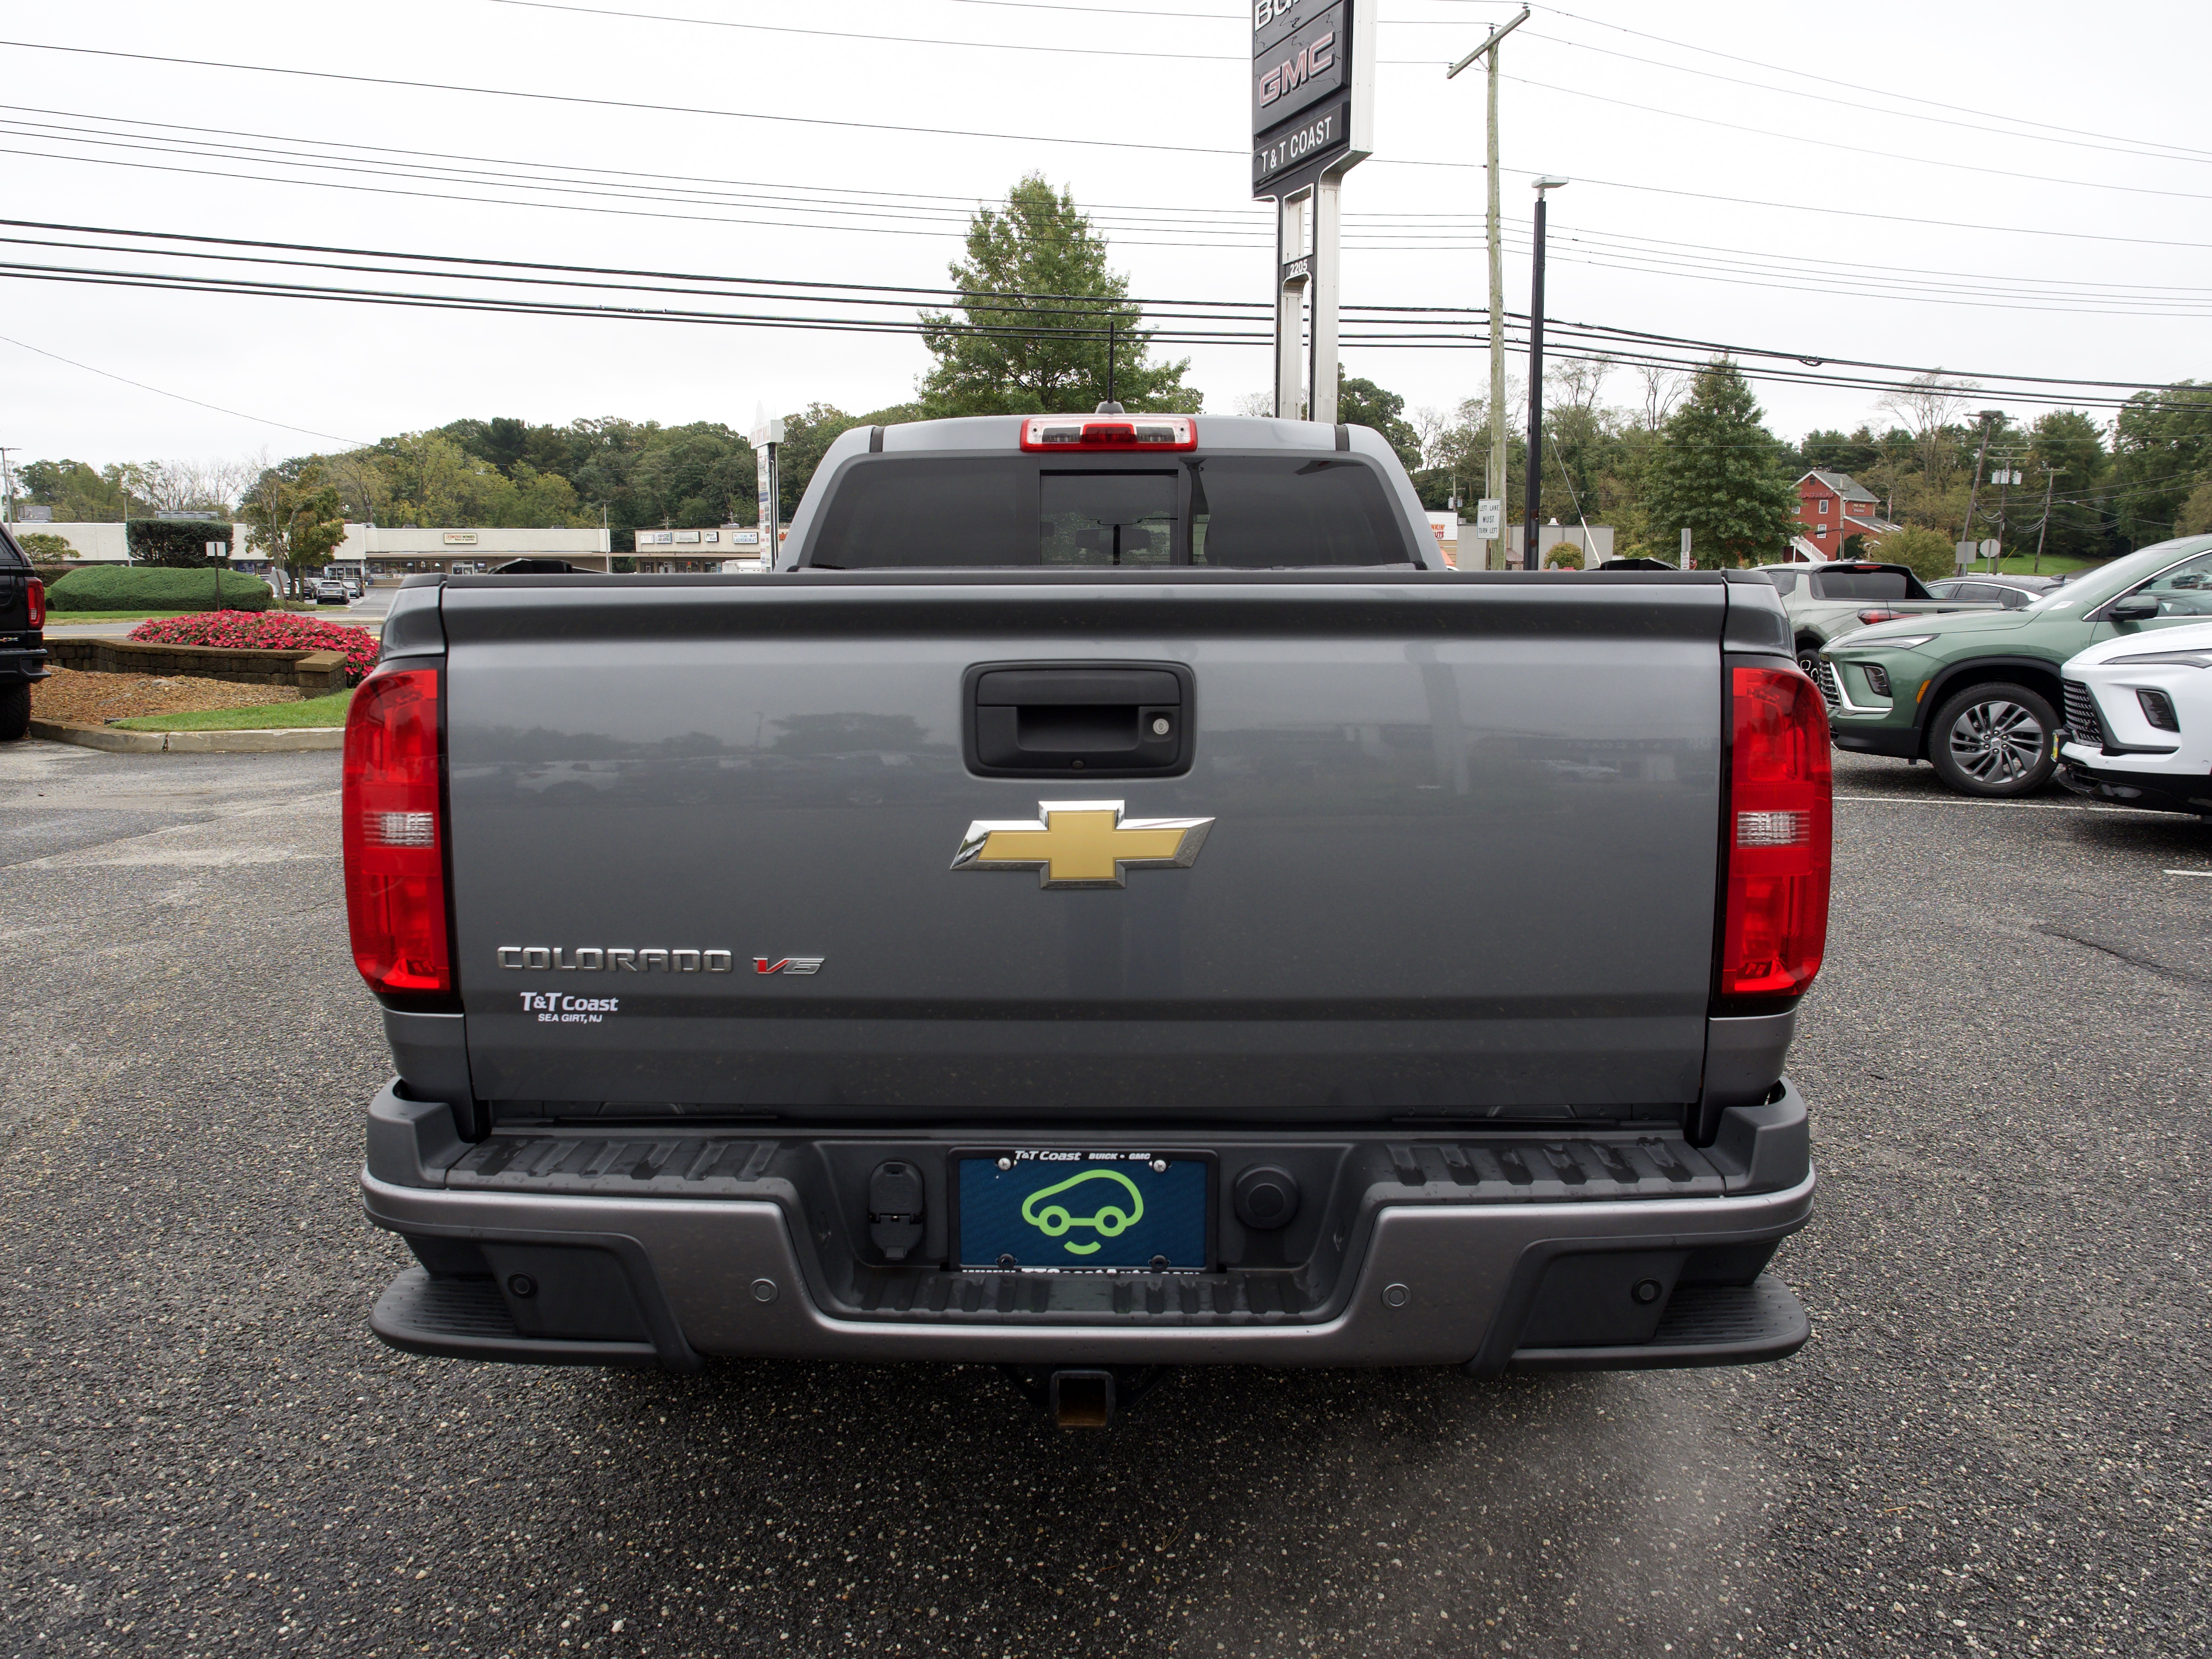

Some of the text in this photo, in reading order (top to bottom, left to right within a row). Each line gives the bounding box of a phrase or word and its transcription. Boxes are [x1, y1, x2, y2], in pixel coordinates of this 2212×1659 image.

[1255, 0, 1300, 32] BU
[1260, 29, 1335, 108] GMC
[1261, 116, 1332, 172] T & T COAST
[1289, 258, 1308, 276] 2205
[498, 946, 825, 974] COLORADO V6
[520, 992, 619, 1011] T&T Coast
[561, 1014, 588, 1024] GIRT,
[1015, 1150, 1039, 1160] T&T
[1039, 1151, 1082, 1161] Coast
